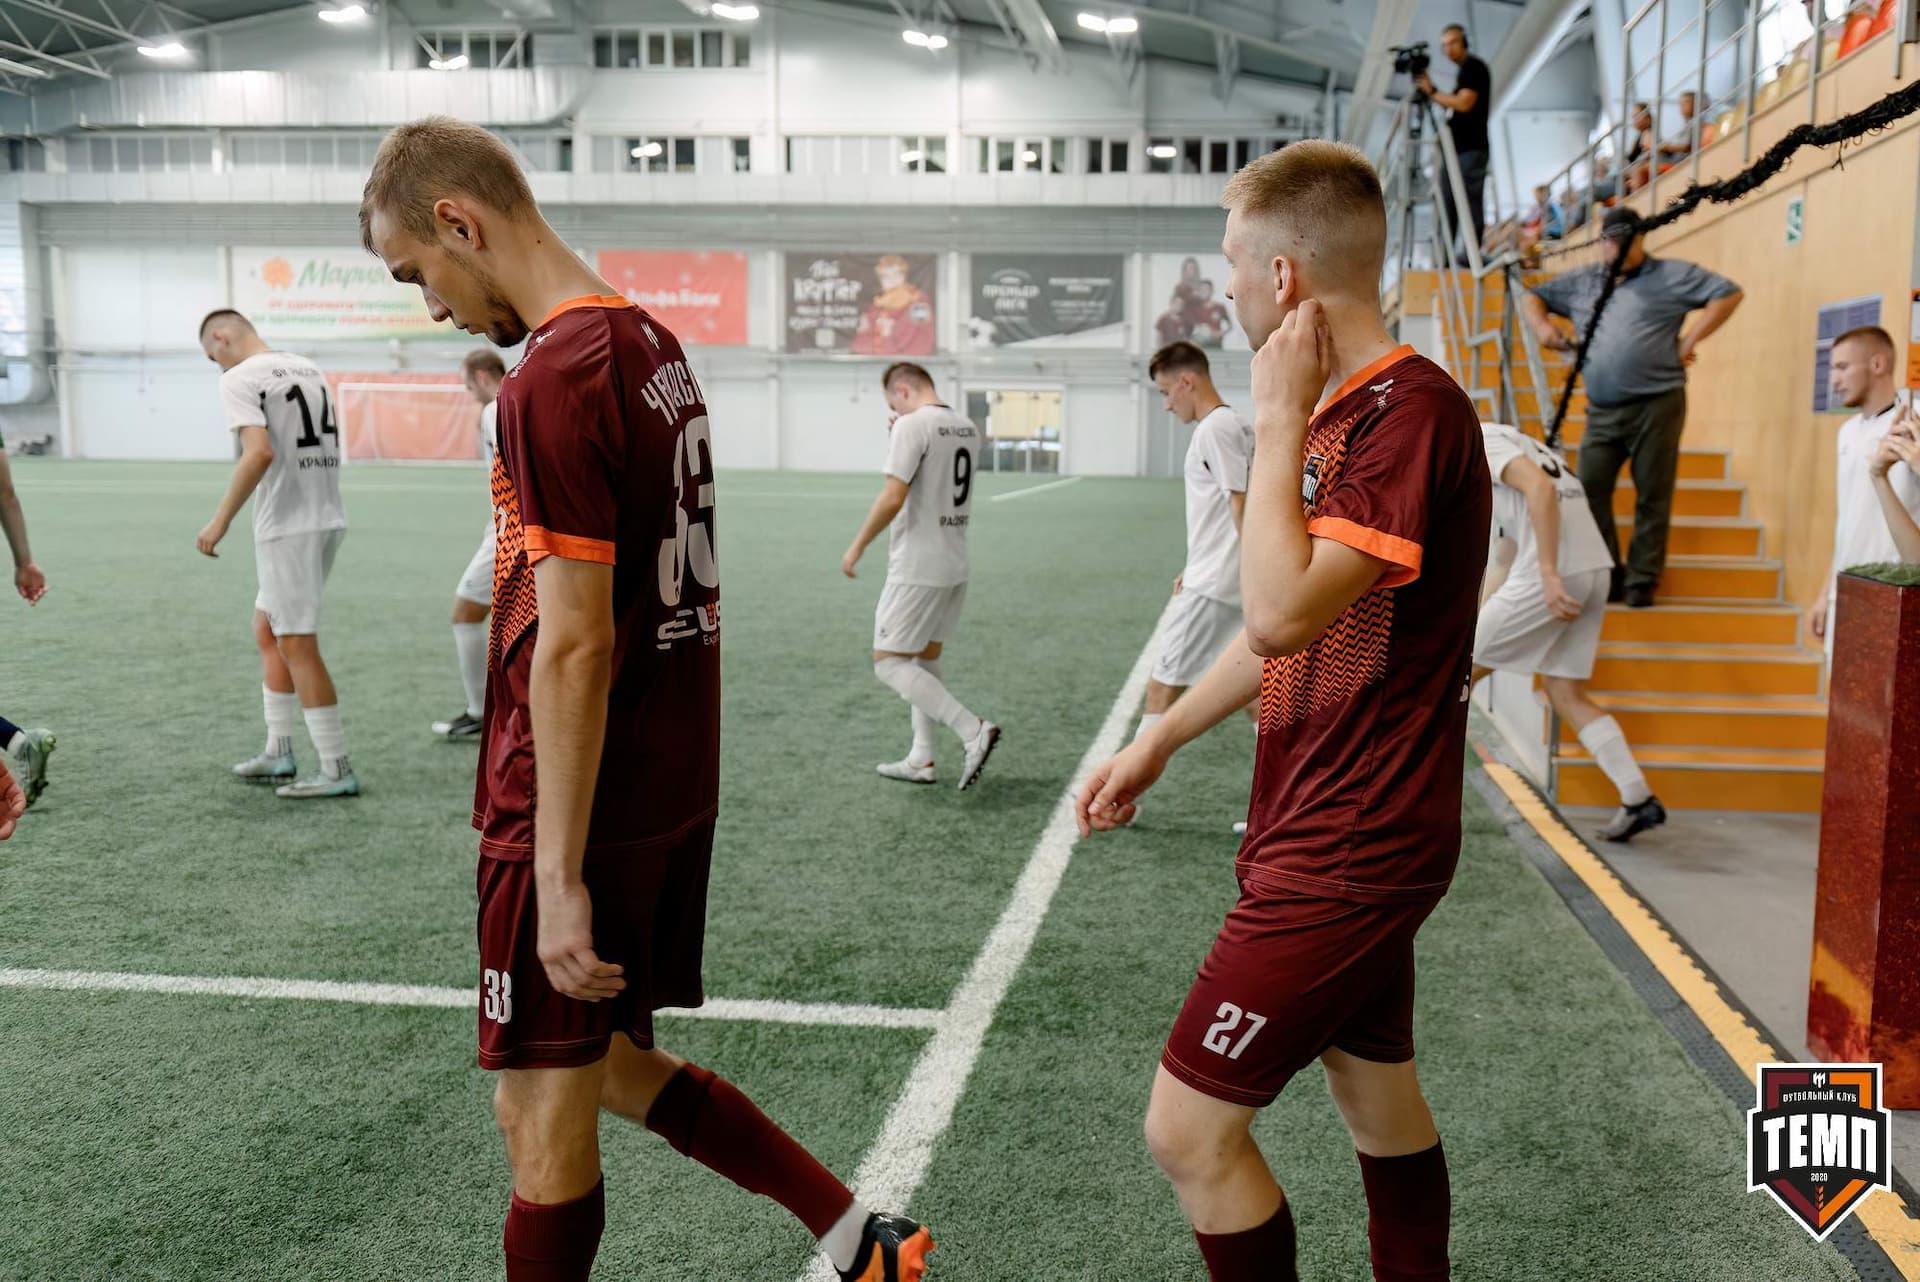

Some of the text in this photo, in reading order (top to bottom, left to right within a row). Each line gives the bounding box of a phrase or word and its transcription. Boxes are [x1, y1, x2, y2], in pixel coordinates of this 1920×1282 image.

[285, 384, 339, 449] 14
[953, 447, 971, 507] 9
[484, 968, 512, 1024] 33
[1202, 1001, 1268, 1060] 27
